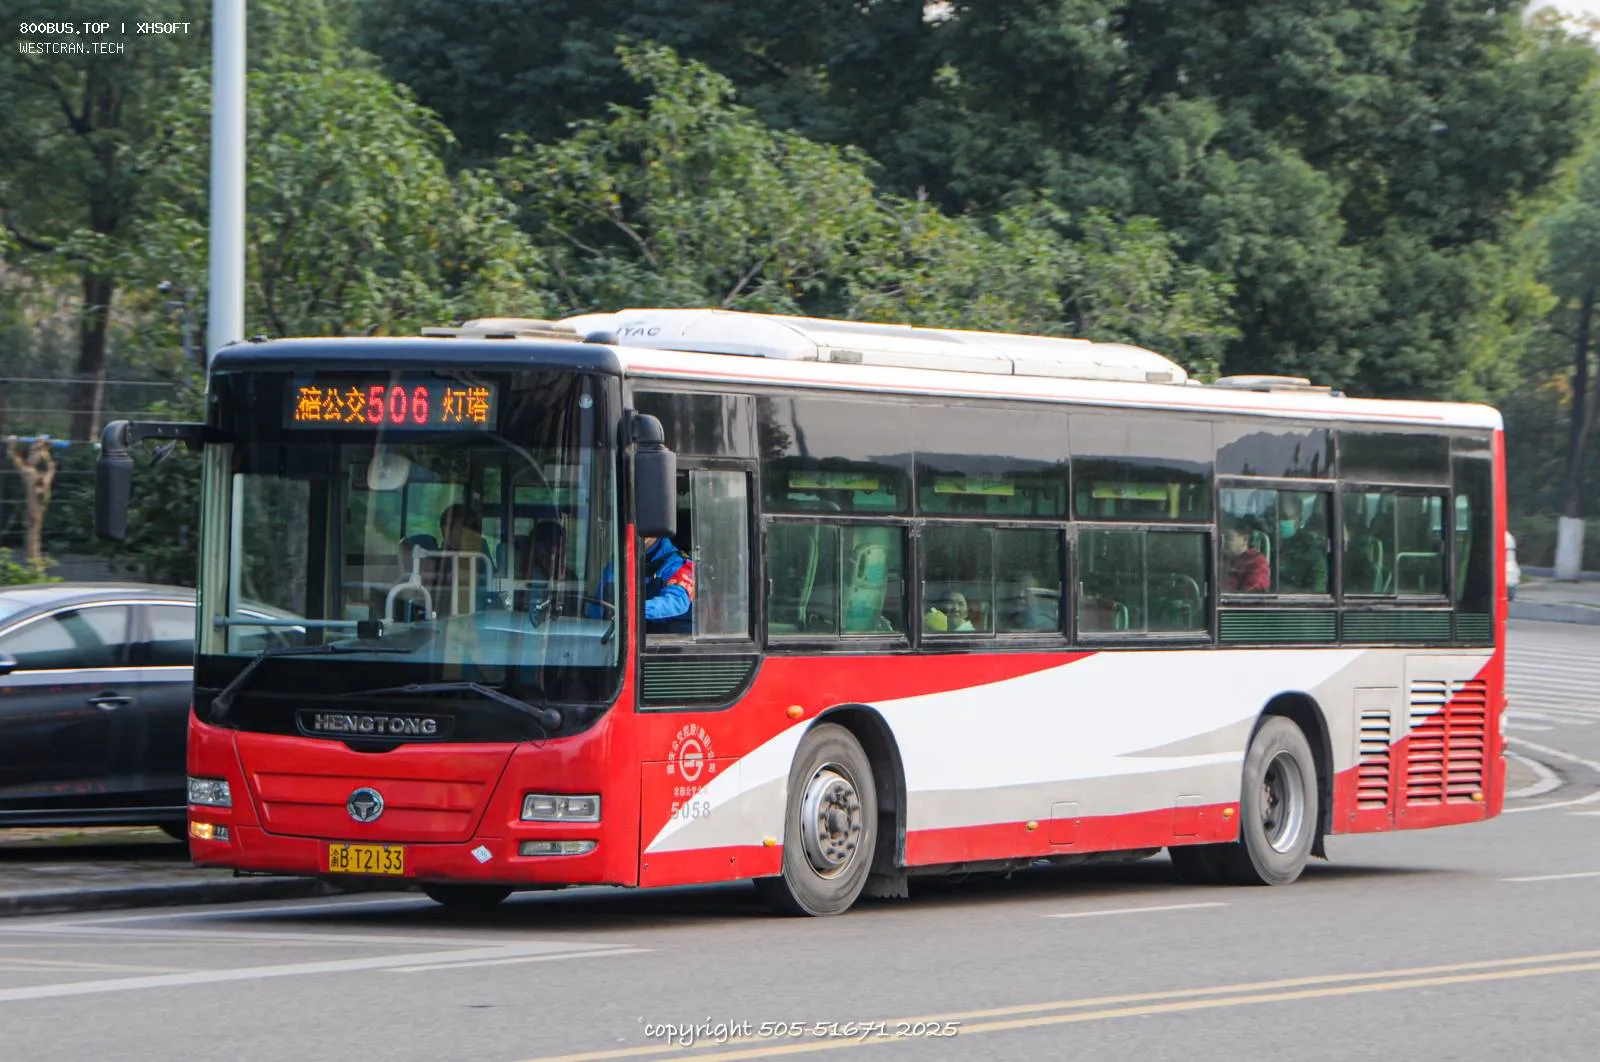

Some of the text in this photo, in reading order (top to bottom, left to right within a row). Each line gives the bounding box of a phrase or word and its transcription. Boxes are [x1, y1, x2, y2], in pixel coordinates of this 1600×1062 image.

[442, 387, 489, 424] 灯塔
[314, 714, 437, 734] HENGTONG
[671, 801, 711, 820] 5058
